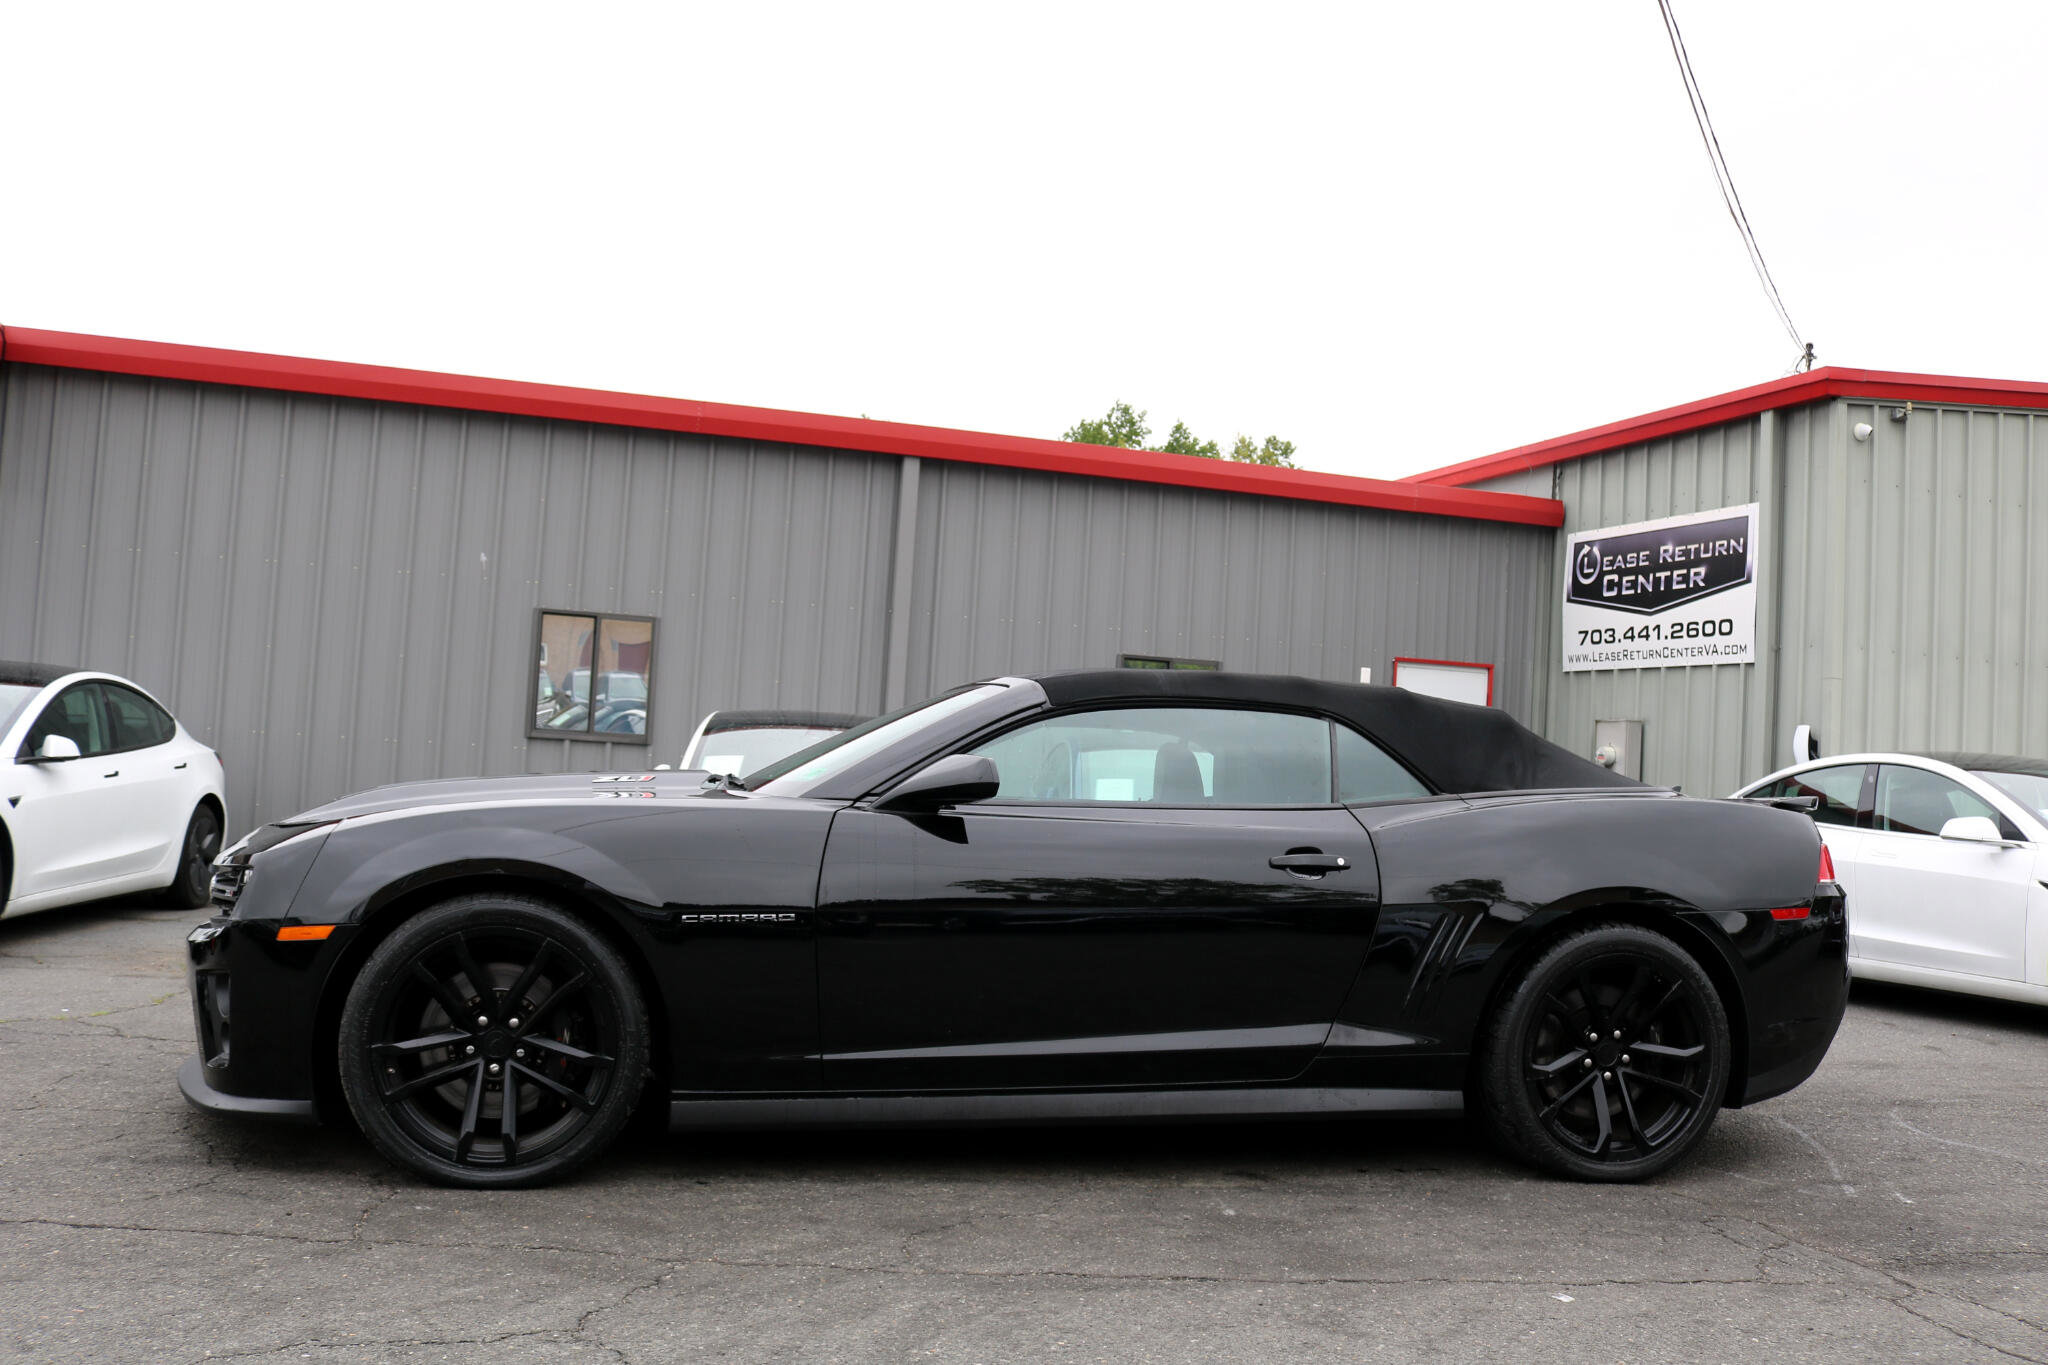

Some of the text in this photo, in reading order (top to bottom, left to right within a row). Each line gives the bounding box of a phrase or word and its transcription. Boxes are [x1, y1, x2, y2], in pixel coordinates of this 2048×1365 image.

[1659, 537, 1744, 564] RETURN
[1602, 567, 1706, 598] CENTER
[1578, 619, 1733, 646] 703.441.2600
[681, 913, 796, 923] CAMARO
